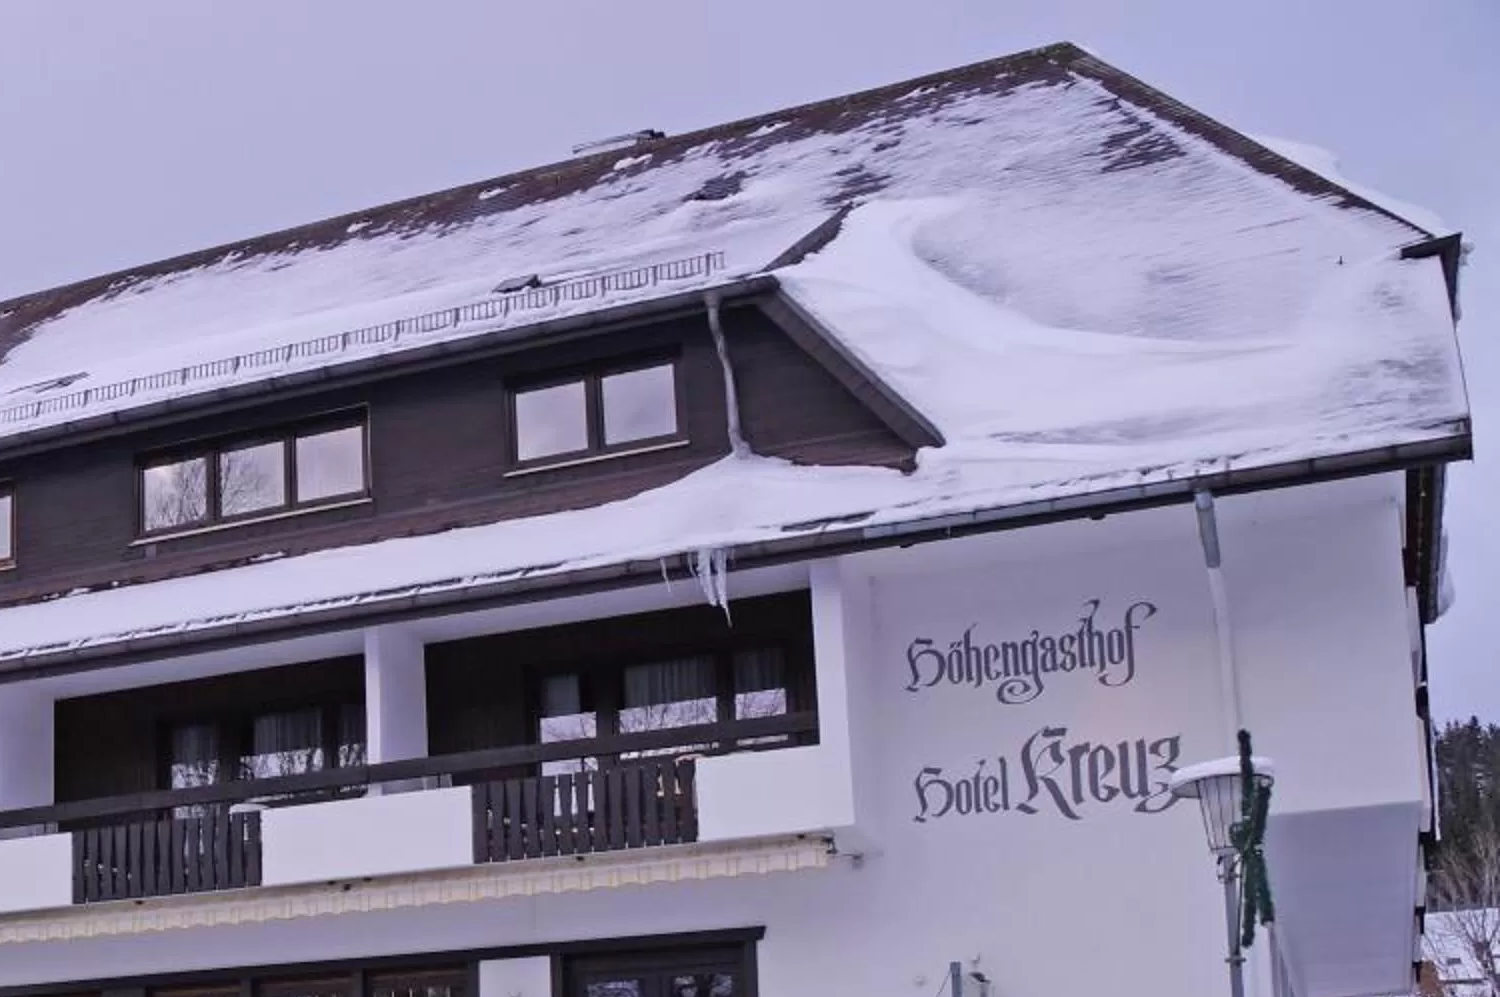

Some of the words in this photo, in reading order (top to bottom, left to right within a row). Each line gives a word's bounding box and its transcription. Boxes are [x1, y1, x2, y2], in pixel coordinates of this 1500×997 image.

[905, 599, 1158, 704] Höhengasthof
[912, 756, 1011, 823] Hotel
[1015, 727, 1182, 820] Kreuz
